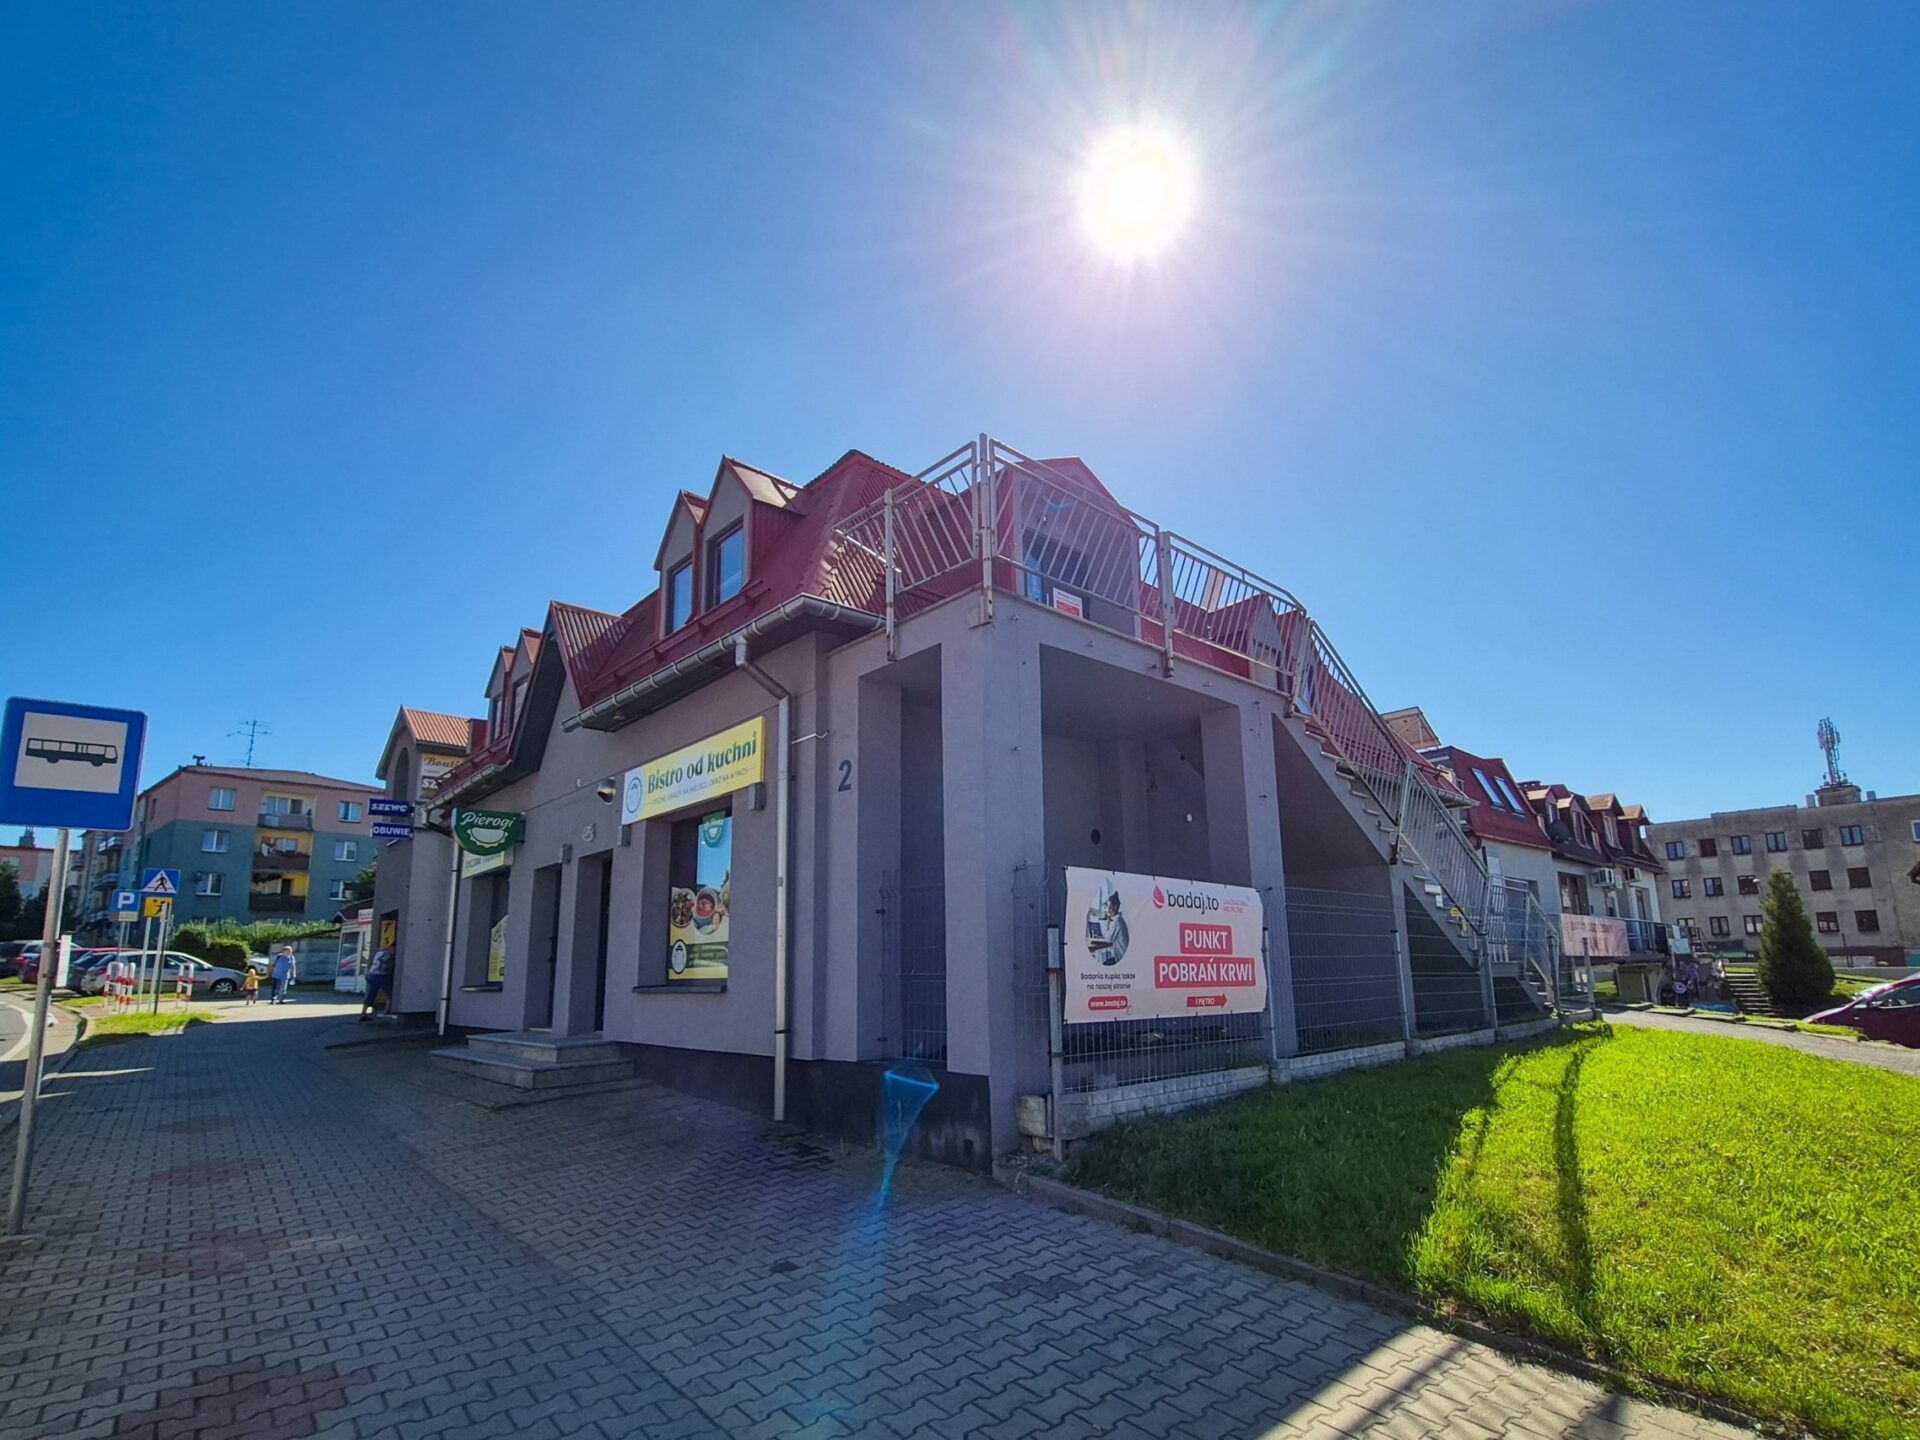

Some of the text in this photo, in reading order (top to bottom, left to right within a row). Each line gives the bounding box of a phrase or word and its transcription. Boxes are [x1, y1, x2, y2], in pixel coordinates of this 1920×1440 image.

[648, 731, 757, 794] Bistro od kuchni
[838, 759, 852, 792] 2
[373, 825, 411, 836] OBUWIE
[460, 811, 517, 830] Pierogi
[117, 891, 135, 909] P
[1166, 889, 1220, 916] badaj.to
[1184, 929, 1228, 950] PUNKT
[1160, 958, 1253, 982] POBRAŃ KRWI
